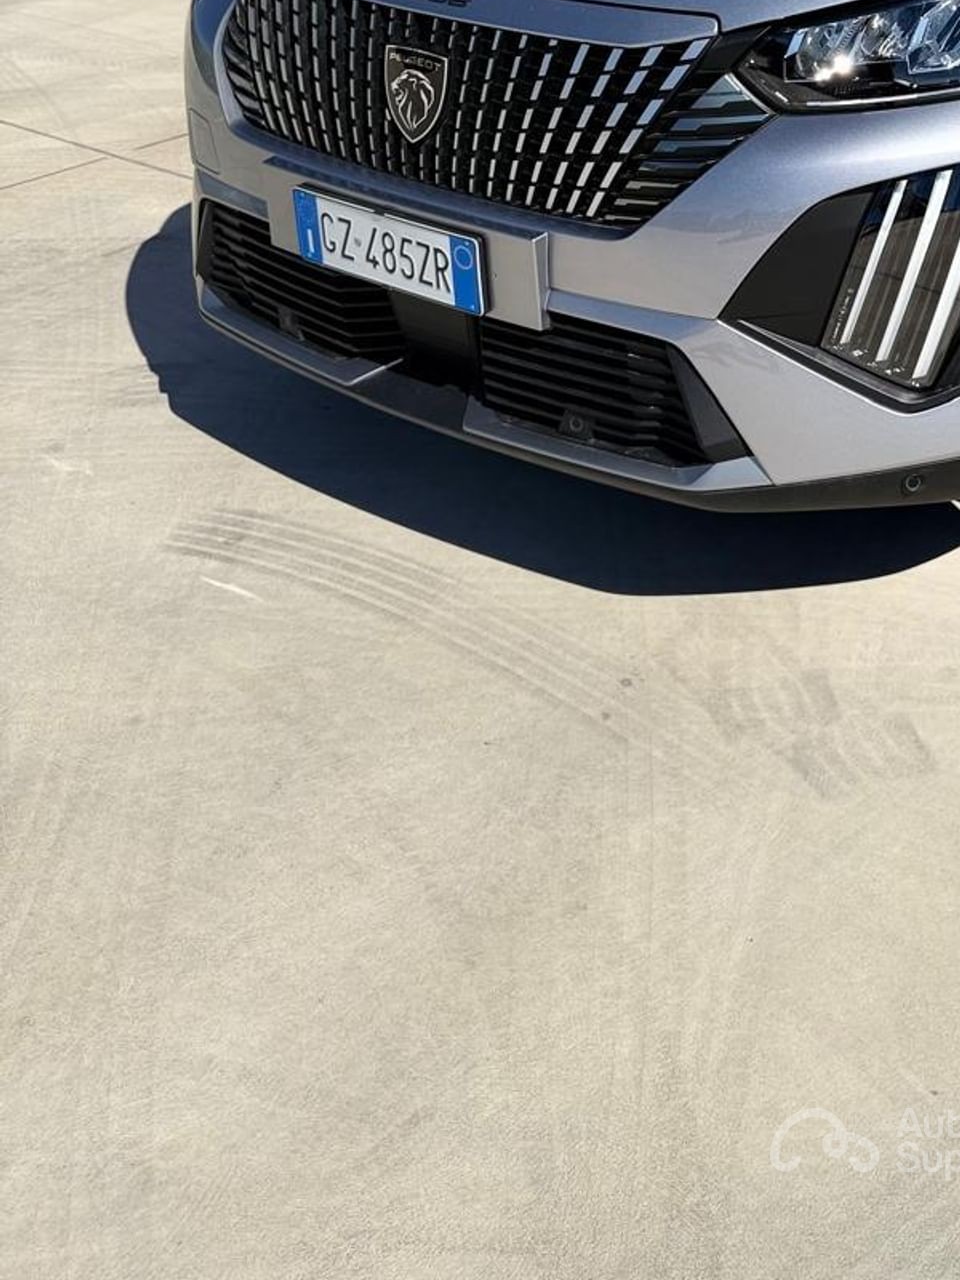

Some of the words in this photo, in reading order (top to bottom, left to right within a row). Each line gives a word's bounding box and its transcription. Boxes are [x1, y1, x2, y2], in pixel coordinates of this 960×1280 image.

[389, 51, 442, 72] PEUGEOT
[321, 212, 355, 261] GZ
[365, 227, 452, 293] 485ZR
